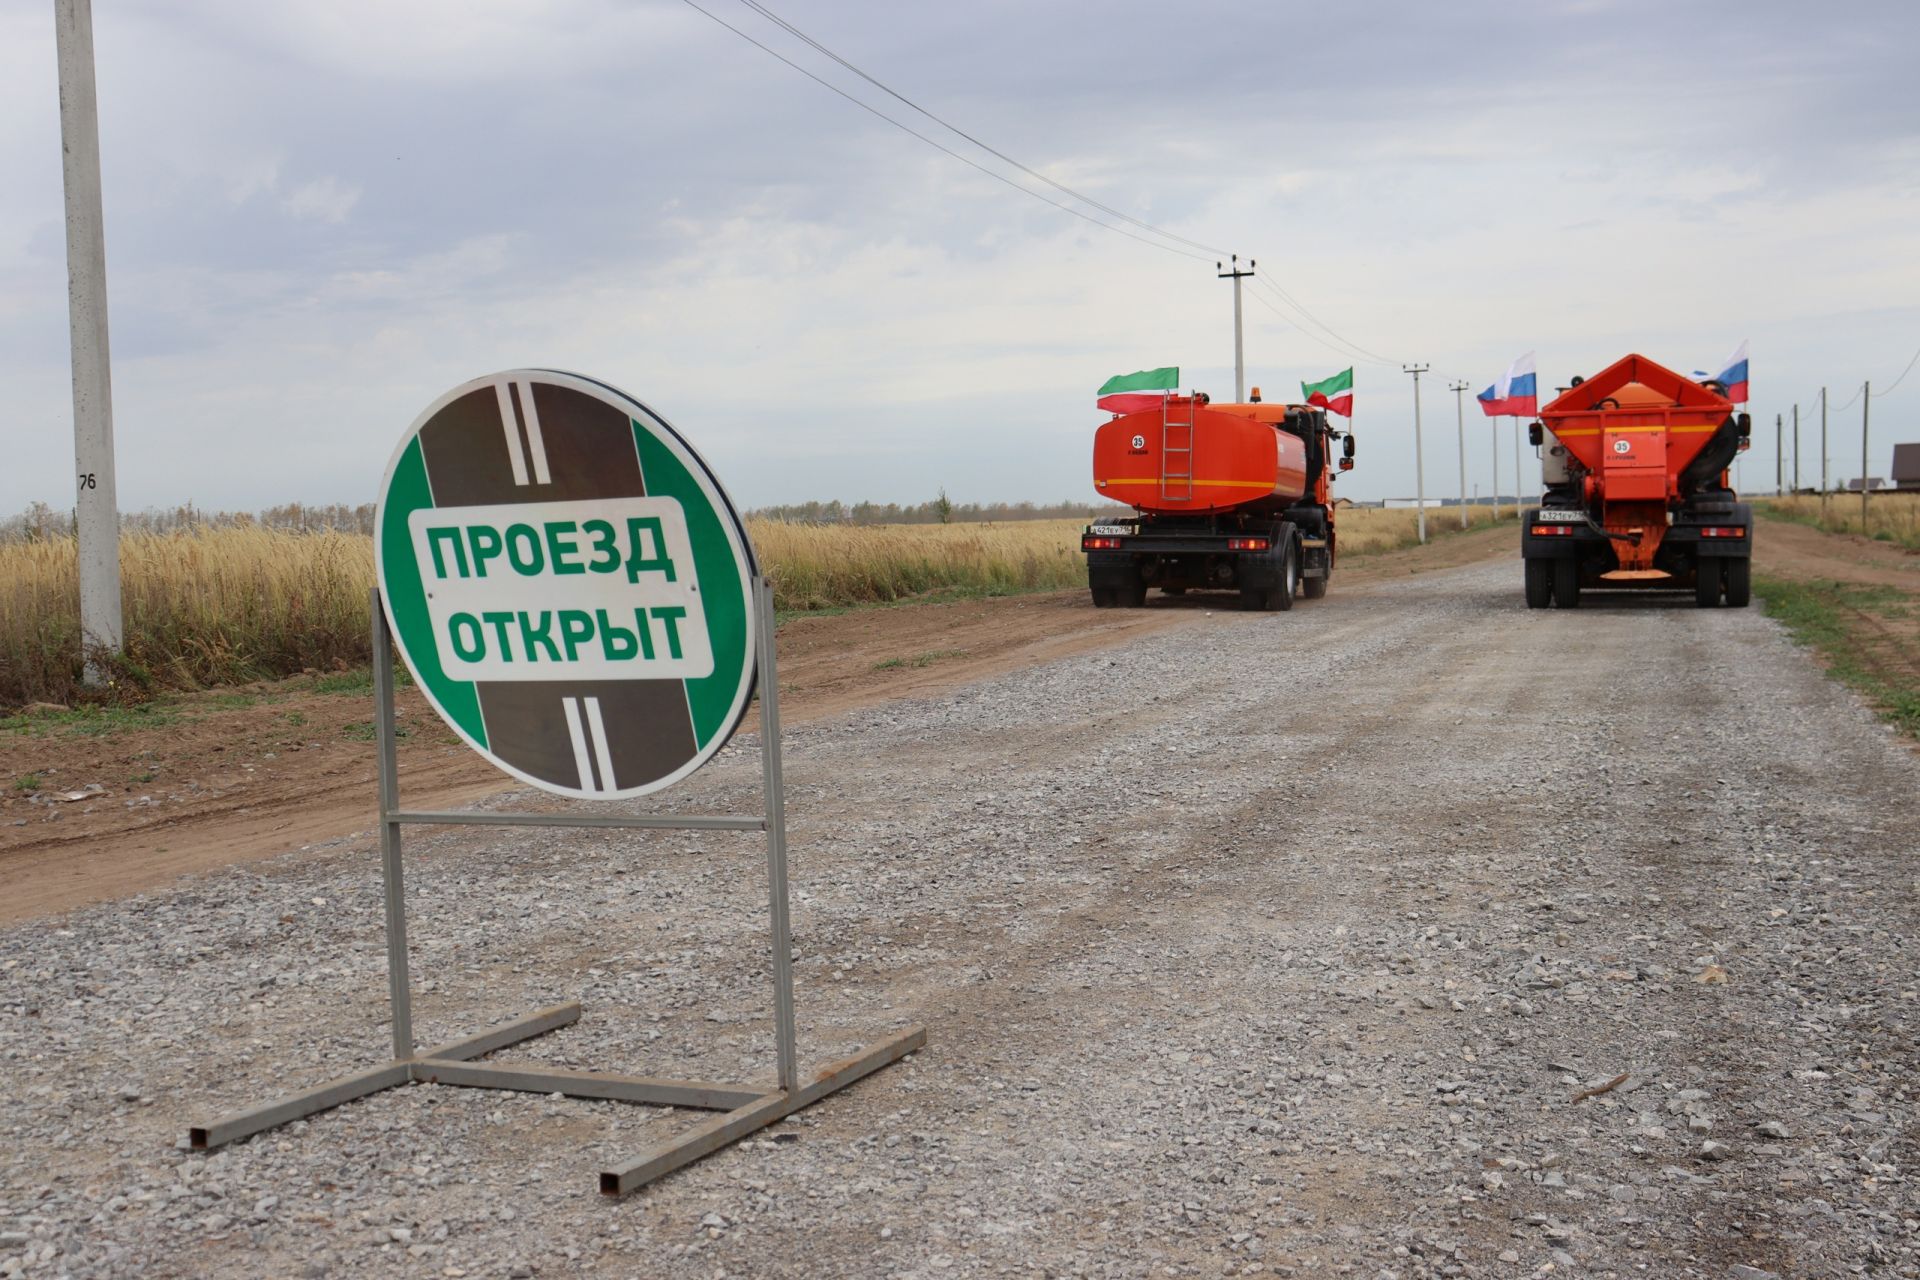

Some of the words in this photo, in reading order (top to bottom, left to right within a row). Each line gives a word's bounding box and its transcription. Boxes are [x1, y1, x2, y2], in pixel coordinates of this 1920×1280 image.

[1133, 437, 1143, 447] 35
[1616, 442, 1628, 452] 35
[79, 473, 96, 491] 76
[426, 516, 678, 584] ПРОЕЗД
[448, 606, 687, 664] ОТКРЫТ
